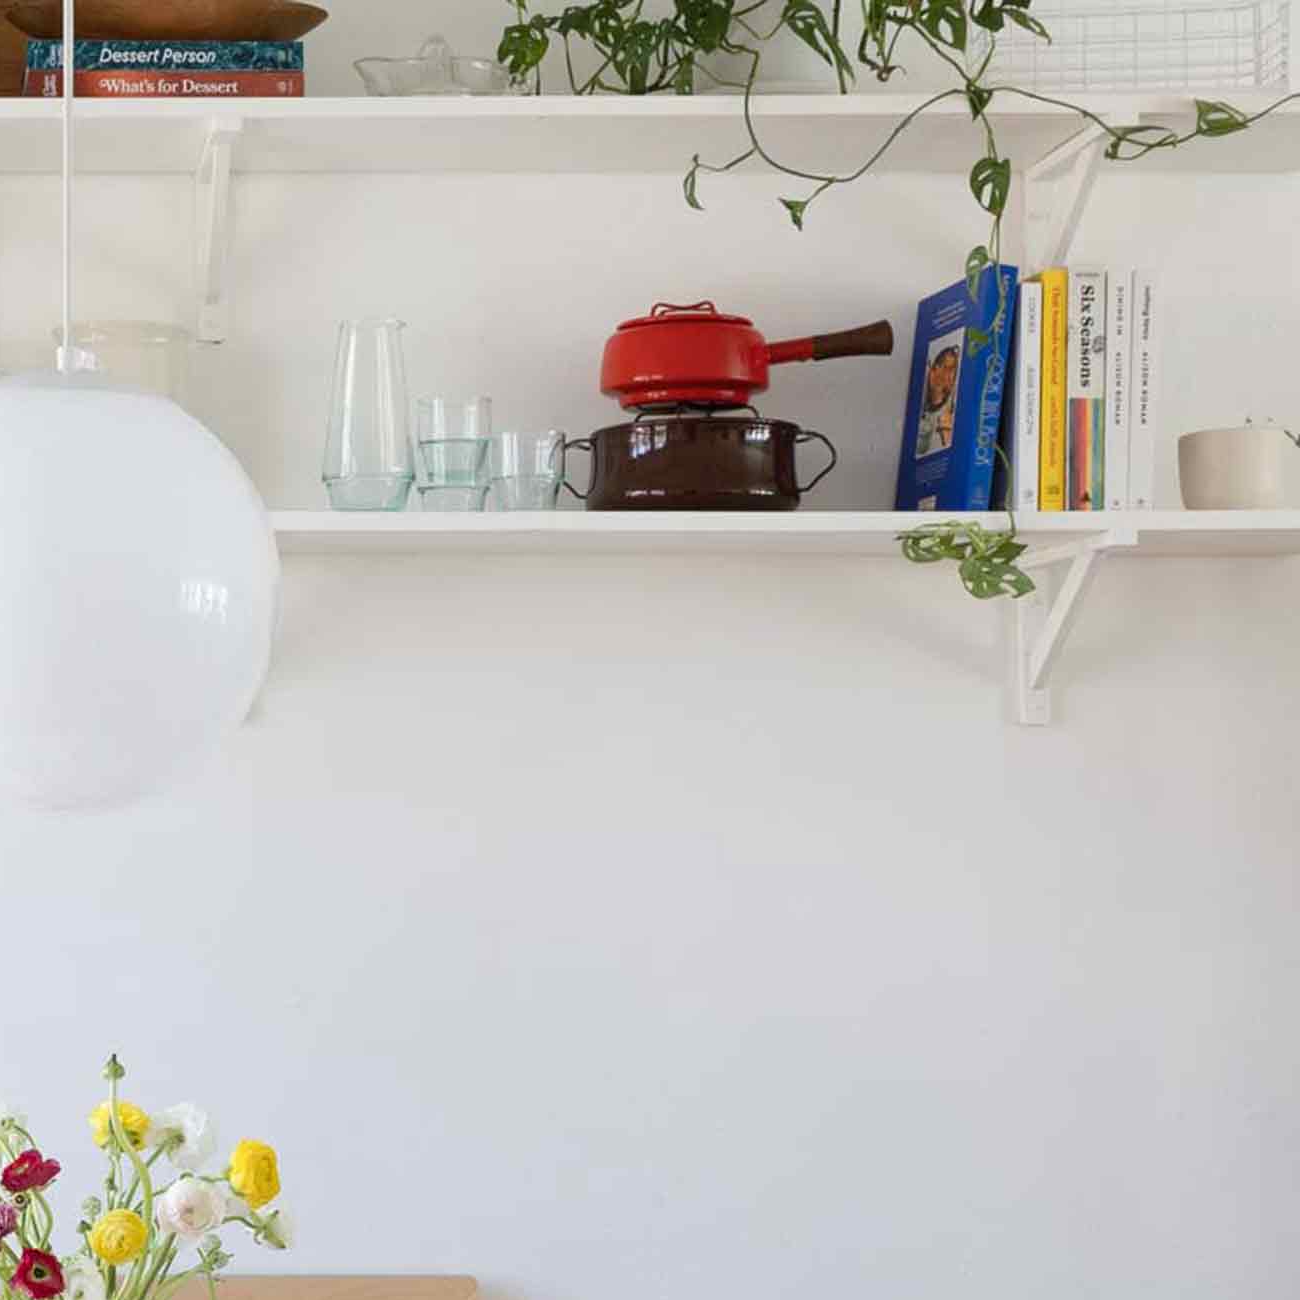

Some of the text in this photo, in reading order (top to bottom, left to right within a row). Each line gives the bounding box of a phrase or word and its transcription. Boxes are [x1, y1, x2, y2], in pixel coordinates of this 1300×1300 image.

[99, 47, 218, 64] Dessert Person
[98, 78, 239, 94] What's for Dessert
[1080, 284, 1096, 313] Six
[1080, 316, 1096, 388] Seasons
